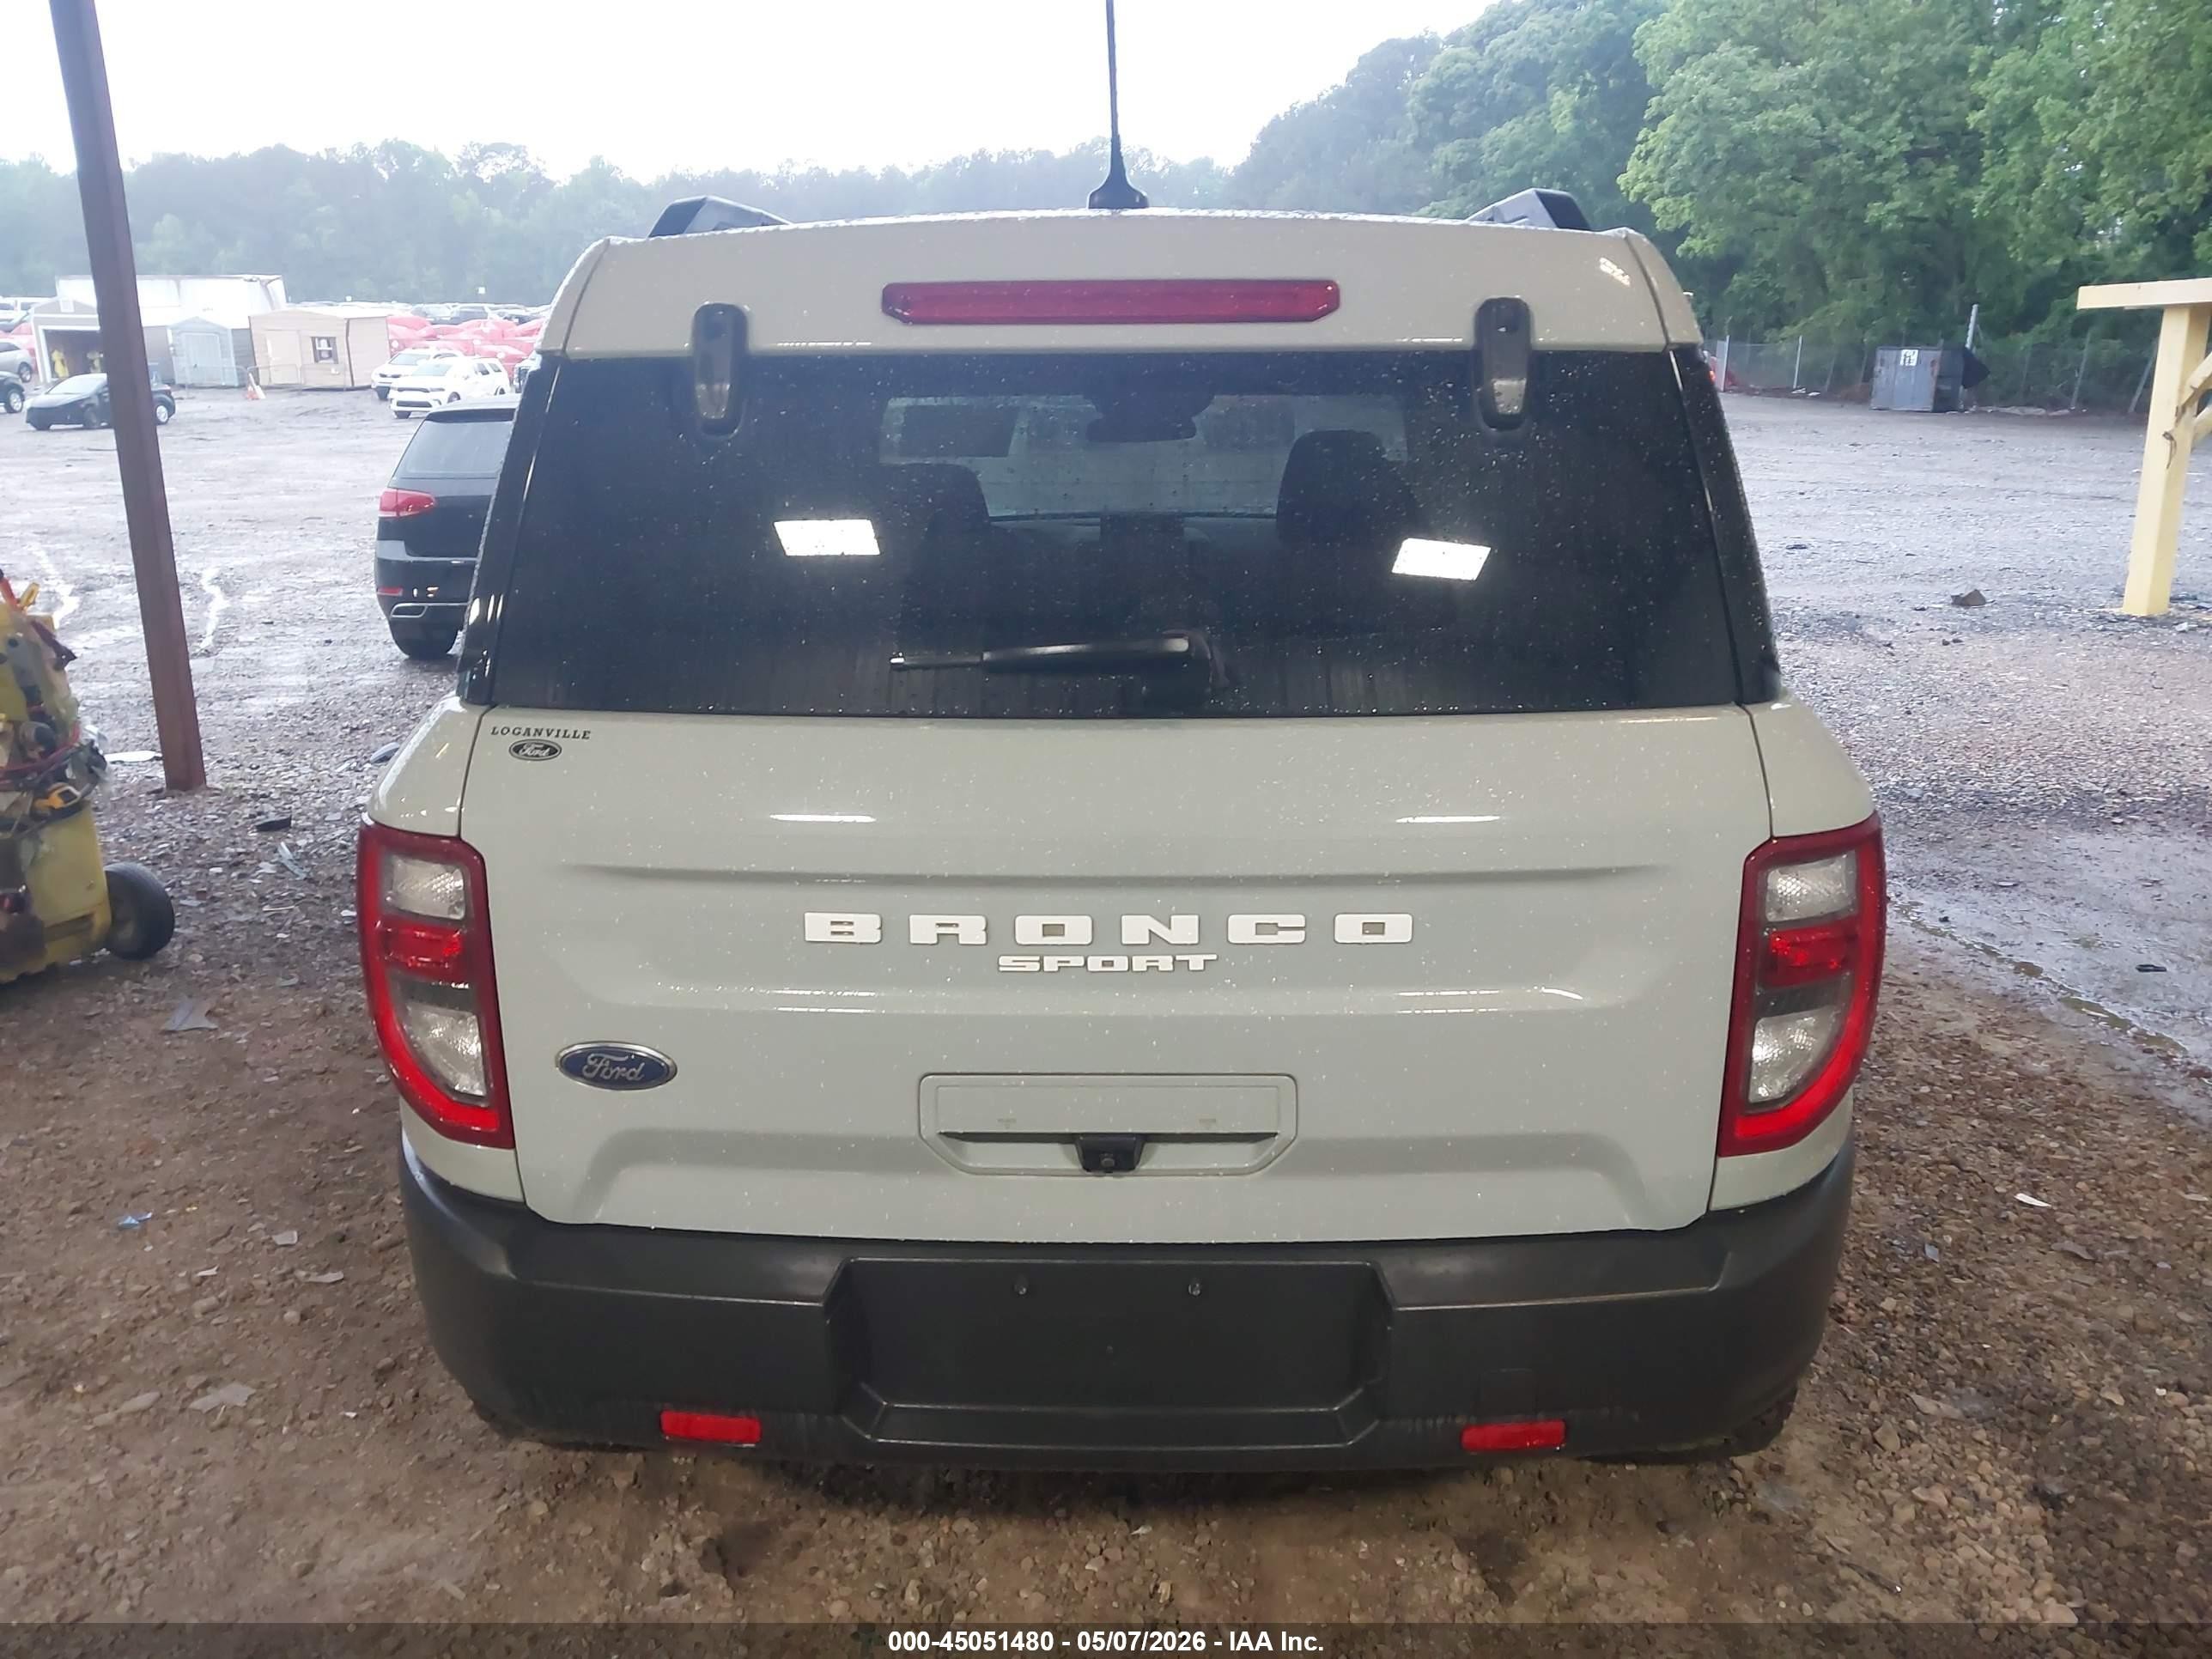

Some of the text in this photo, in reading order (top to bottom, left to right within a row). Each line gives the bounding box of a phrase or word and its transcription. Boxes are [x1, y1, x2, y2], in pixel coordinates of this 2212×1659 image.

[490, 726, 591, 739] LOGANVILLE
[804, 912, 1413, 945] BRONCO
[998, 954, 1218, 972] SPORT
[581, 1053, 645, 1081] Ford
